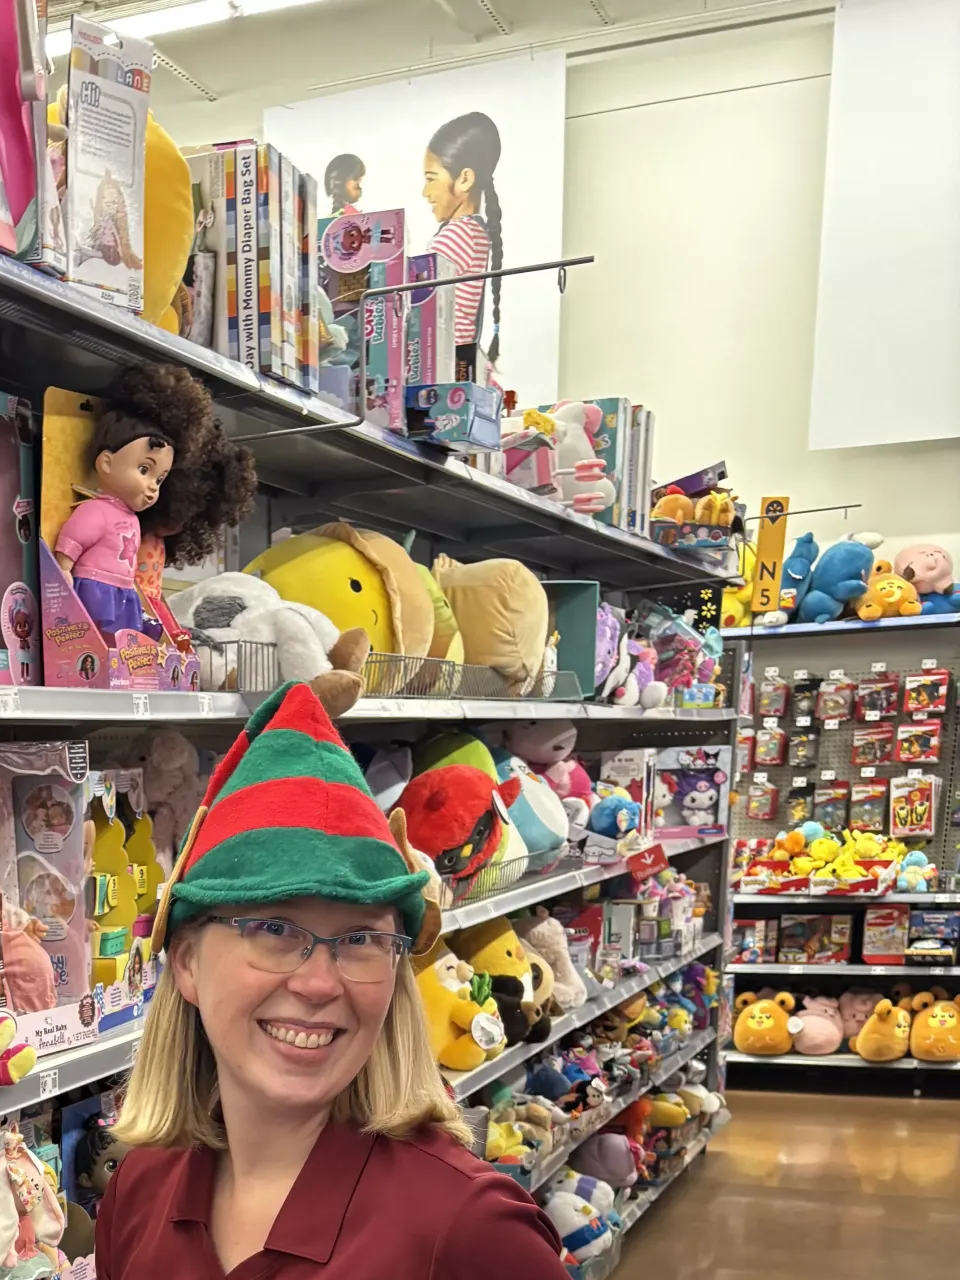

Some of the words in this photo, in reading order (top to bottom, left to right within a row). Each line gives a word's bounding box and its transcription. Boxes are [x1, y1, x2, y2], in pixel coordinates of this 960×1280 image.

[81, 81, 100, 108] Hi!
[241, 155, 252, 176] Set
[241, 179, 254, 205] Bag
[241, 208, 256, 254] Diaper
[242, 257, 255, 310] Mommy
[242, 313, 253, 344] with
[759, 561, 777, 581] N
[759, 588, 771, 606] 5
